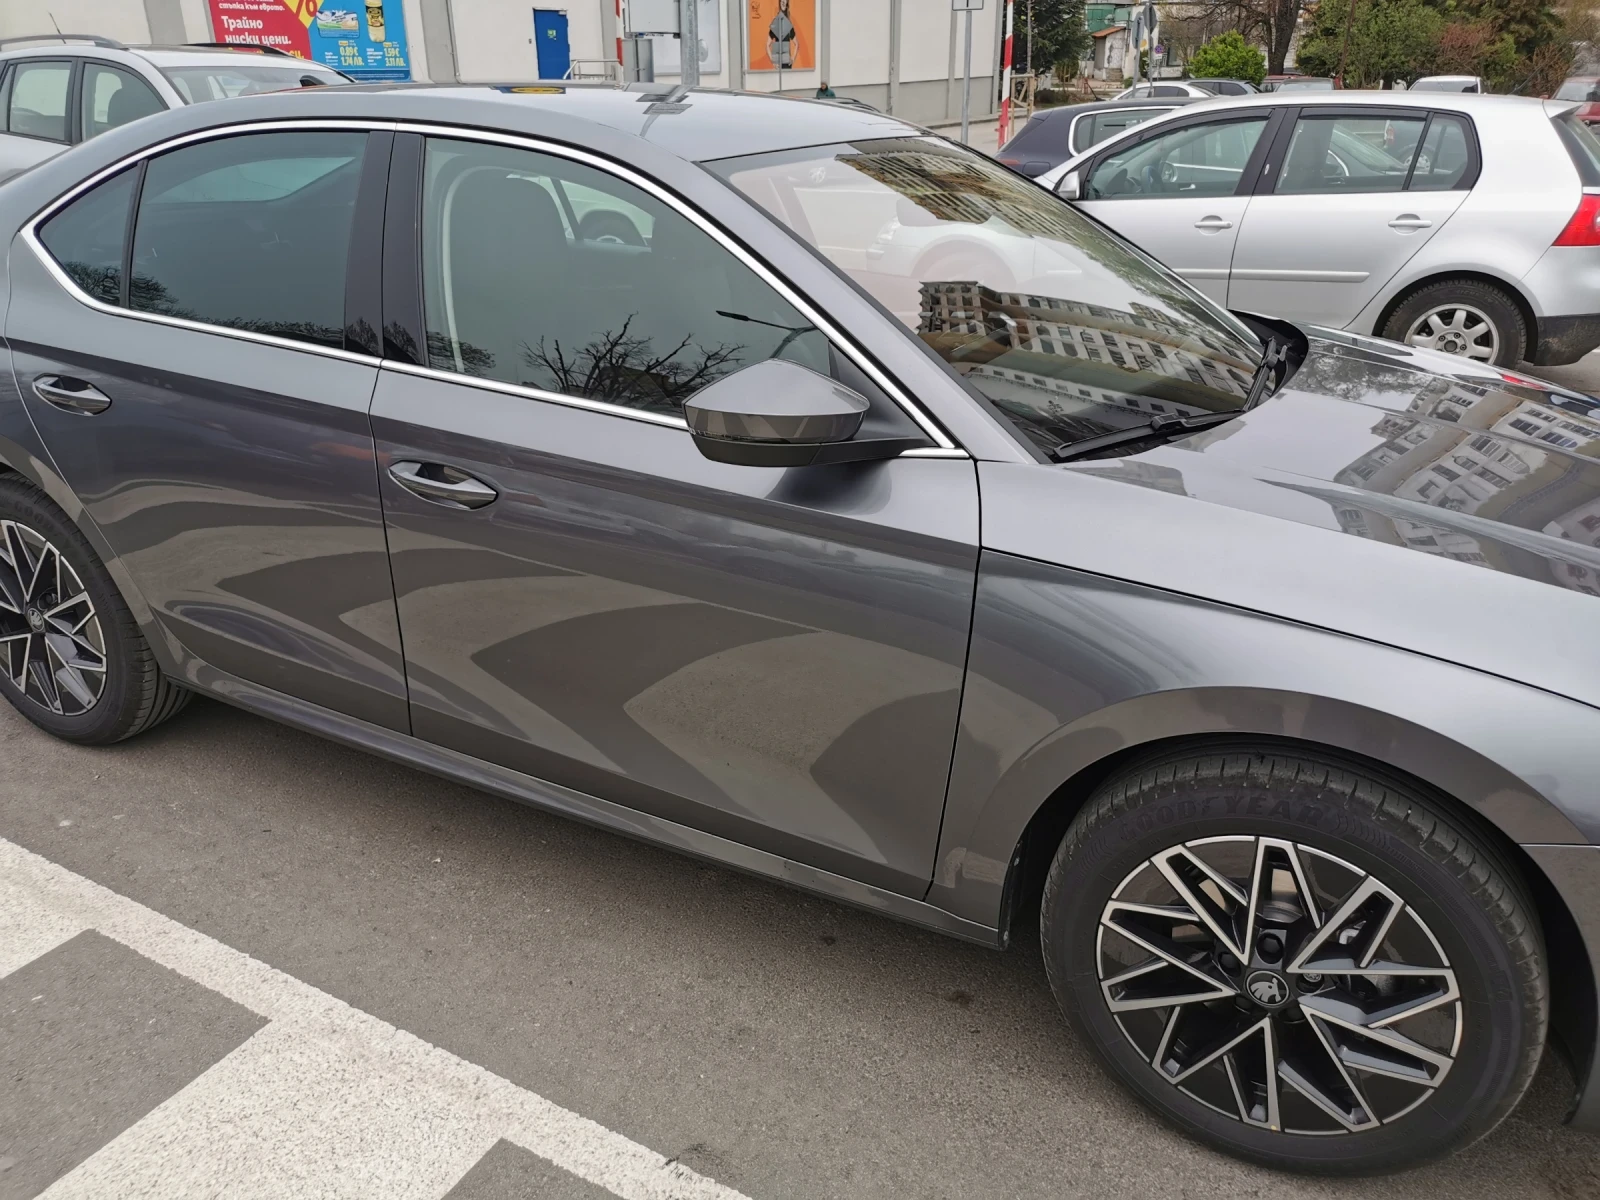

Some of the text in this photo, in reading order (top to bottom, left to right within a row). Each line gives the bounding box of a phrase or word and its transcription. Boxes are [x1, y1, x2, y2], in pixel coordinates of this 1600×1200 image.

[221, 15, 263, 31] Трайно
[224, 32, 292, 46] ниски цени.
